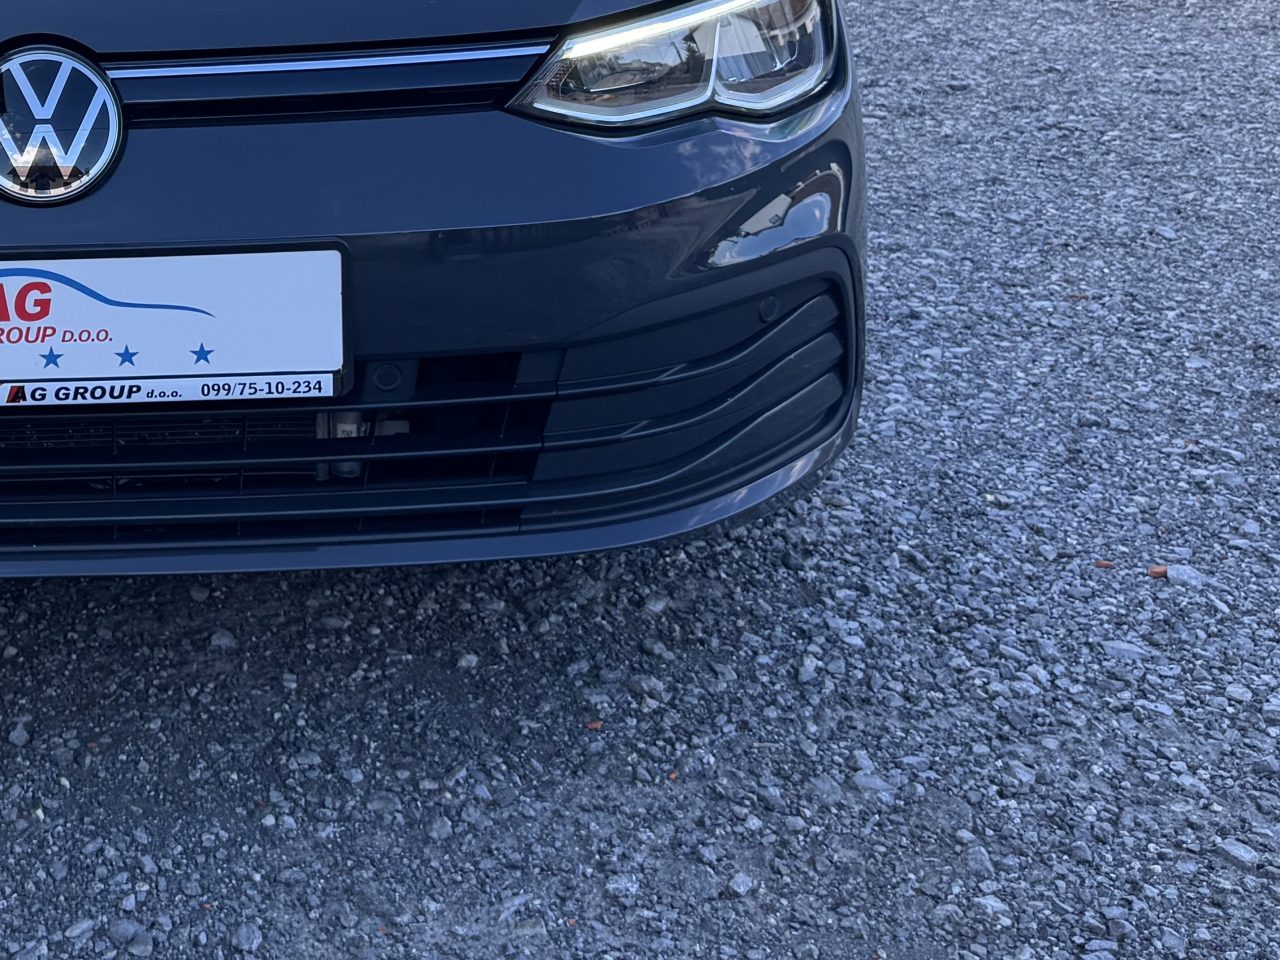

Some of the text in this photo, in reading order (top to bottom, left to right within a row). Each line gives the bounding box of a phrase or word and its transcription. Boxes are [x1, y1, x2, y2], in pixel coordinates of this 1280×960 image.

[61, 328, 113, 343] D.O.O.
[5, 379, 323, 404] AG GROUP d.o.o. 099/75-10-234
